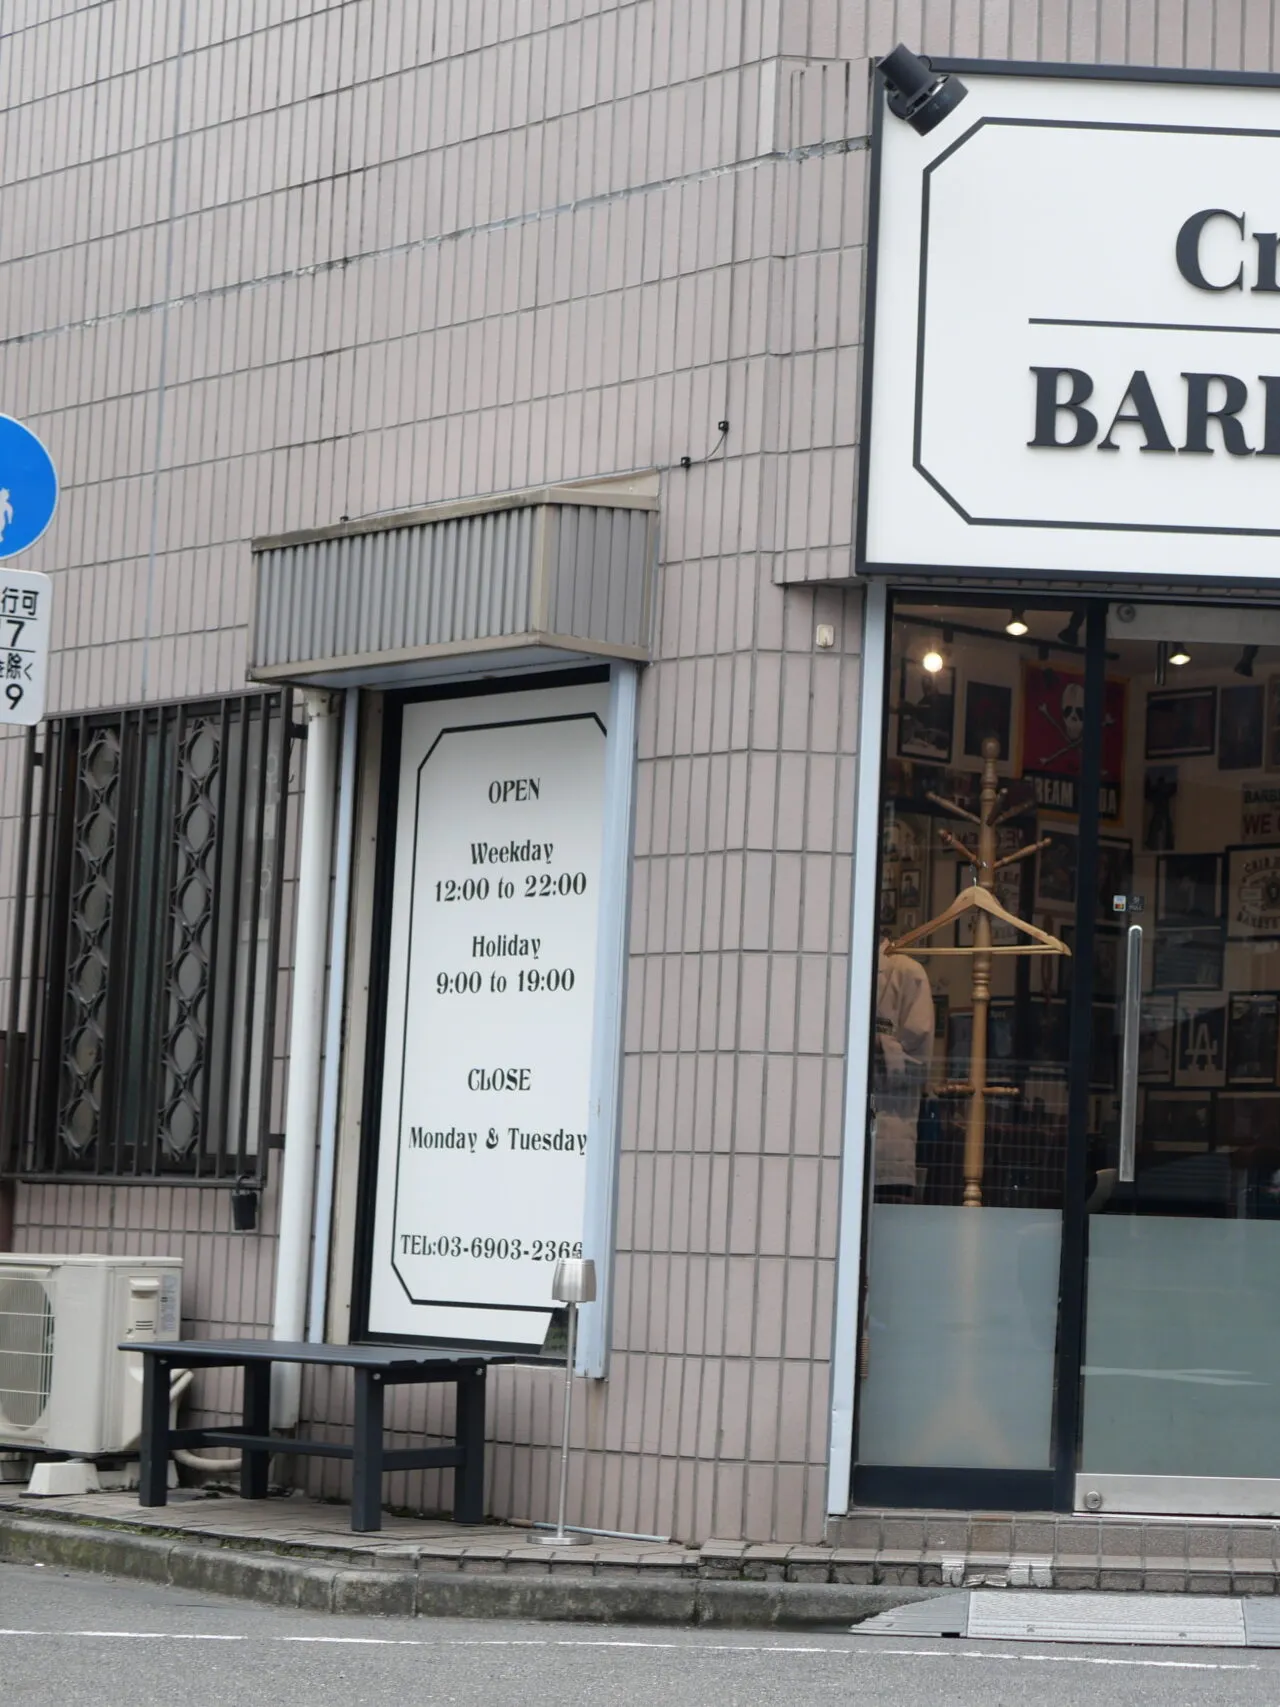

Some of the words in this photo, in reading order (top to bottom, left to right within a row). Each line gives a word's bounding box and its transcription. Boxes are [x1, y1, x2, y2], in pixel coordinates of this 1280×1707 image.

[488, 778, 540, 804] OPEN
[1024, 775, 1074, 808] REAM
[1243, 813, 1272, 835] WE
[470, 839, 554, 865] Weekday
[435, 877, 490, 902] 12:00
[498, 877, 515, 899] to
[524, 872, 587, 898] 22:00
[471, 934, 541, 958] Holiday
[436, 972, 482, 995] 9:00
[490, 972, 507, 993] to
[517, 967, 575, 993] 19:00
[467, 1068, 532, 1092] CLOSE
[409, 1127, 478, 1151] Monday
[485, 1128, 499, 1150] &
[507, 1127, 588, 1152] Tuesday
